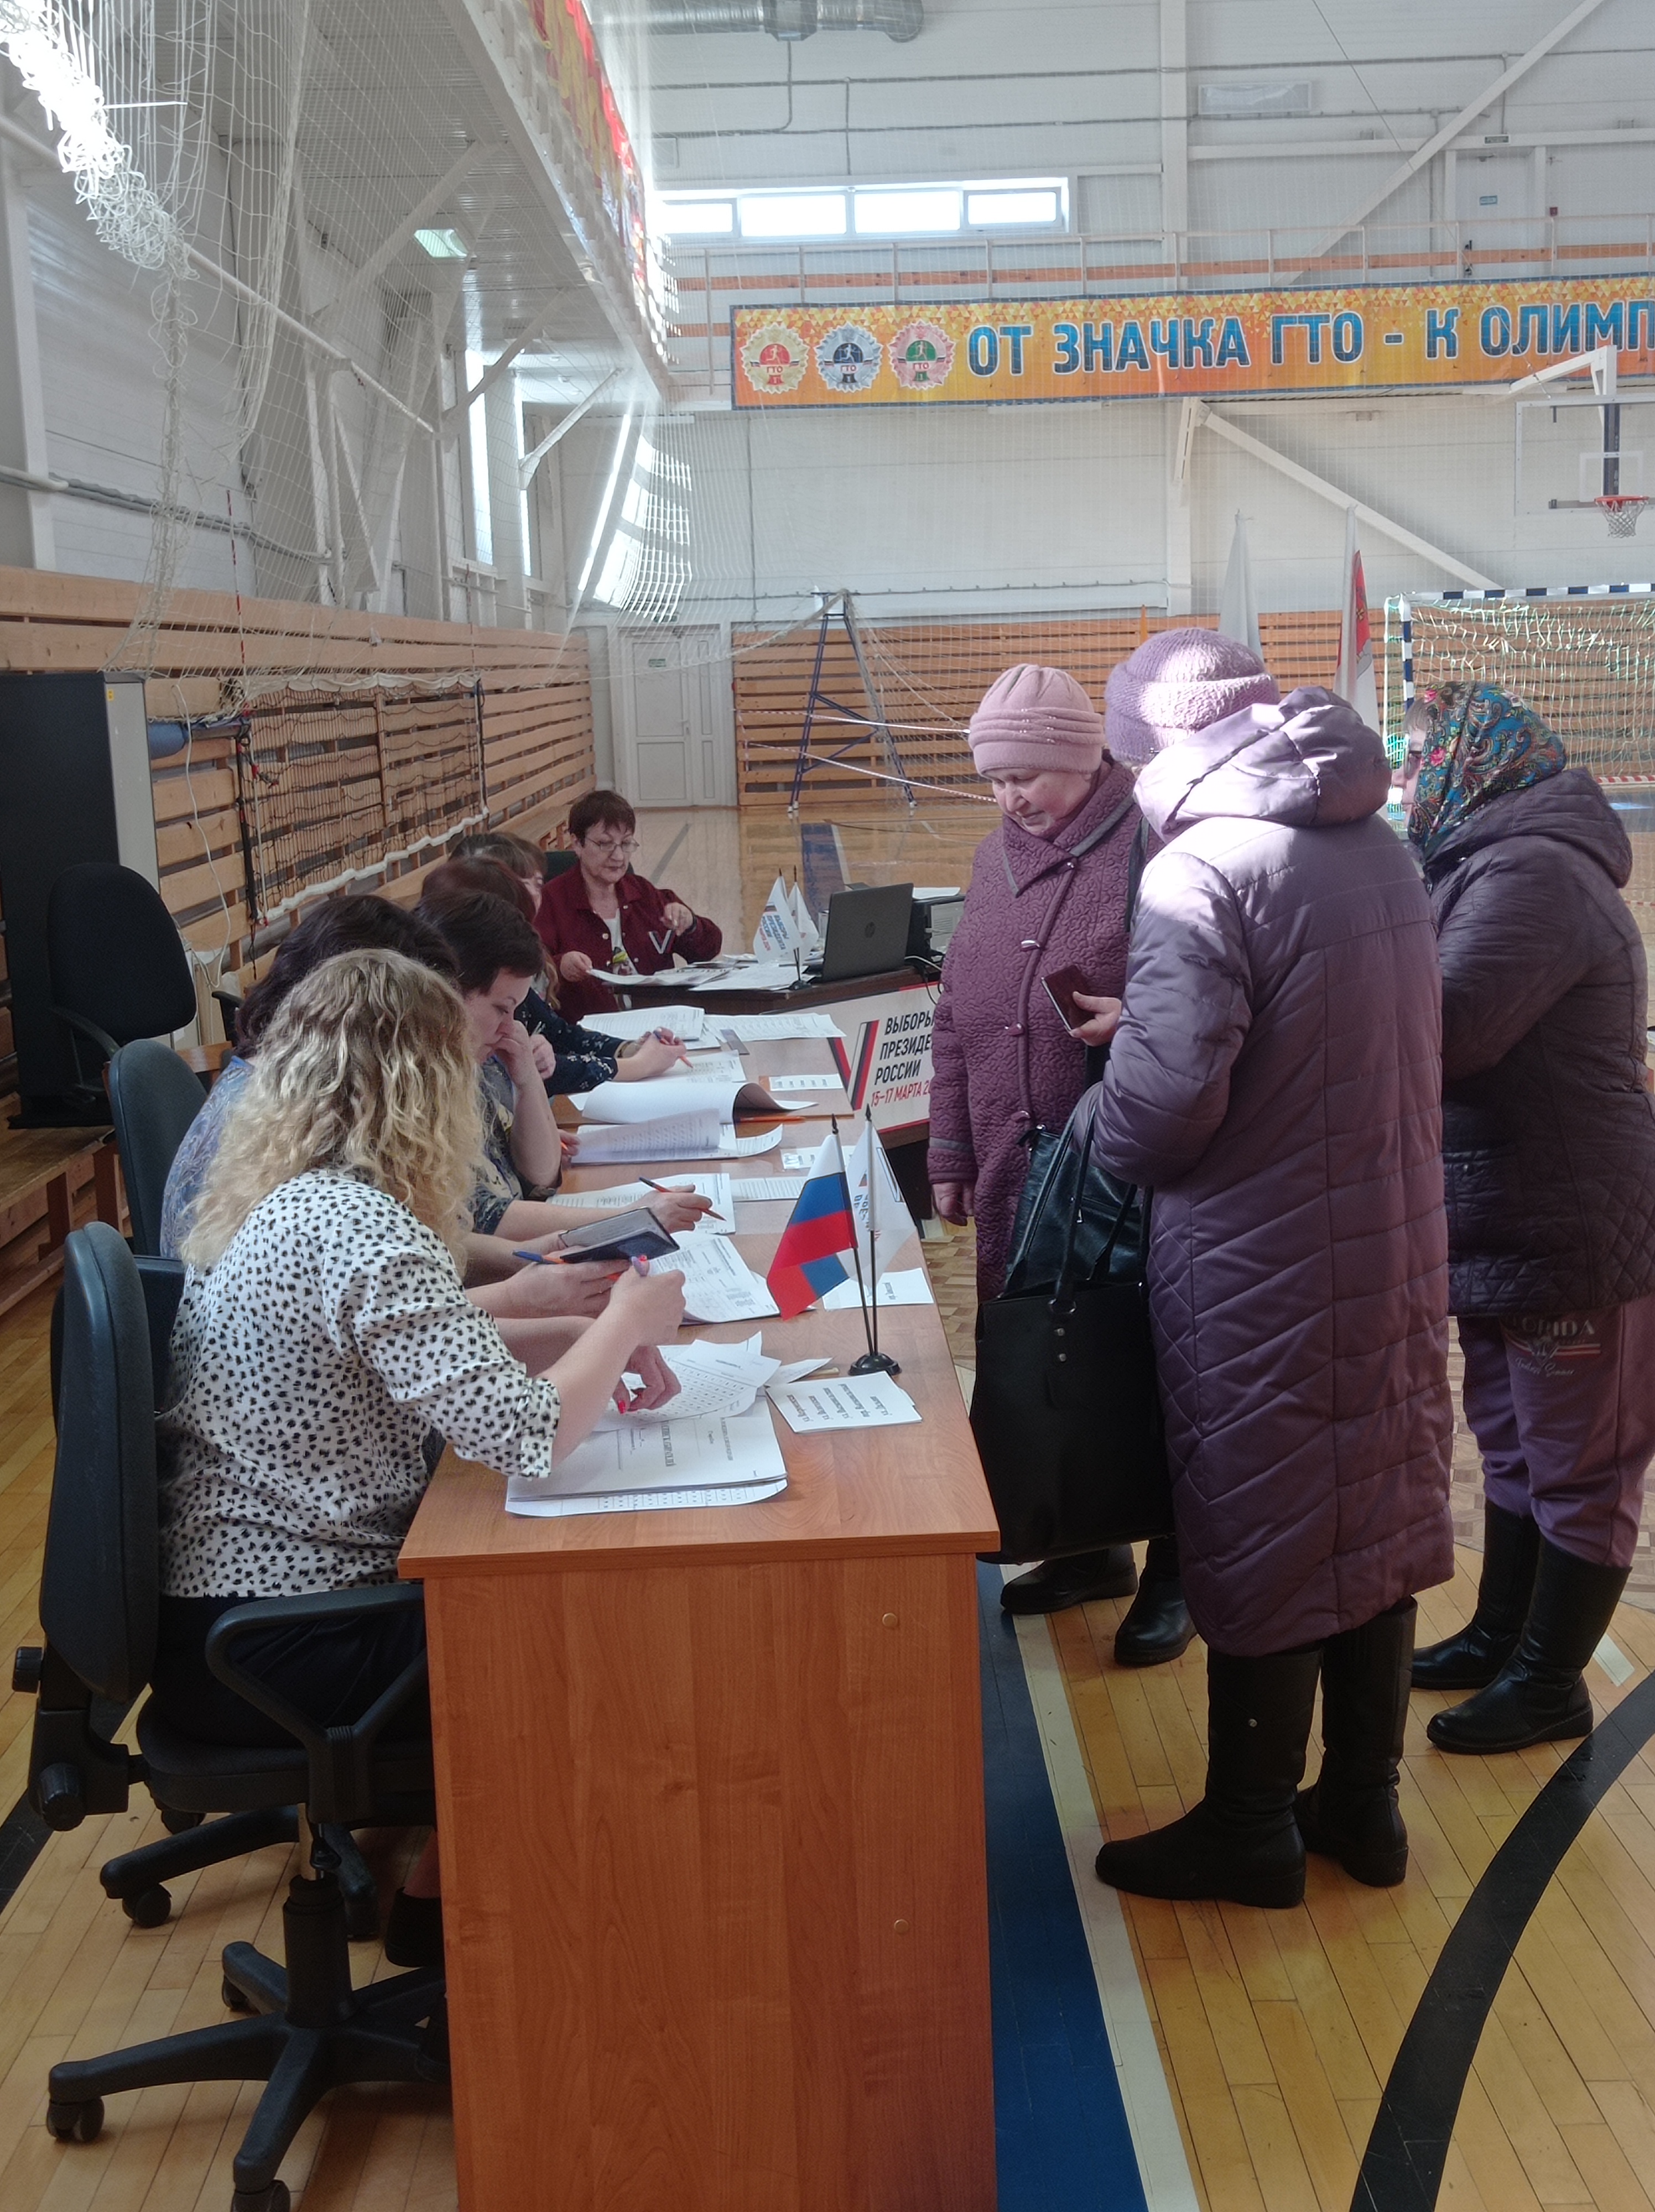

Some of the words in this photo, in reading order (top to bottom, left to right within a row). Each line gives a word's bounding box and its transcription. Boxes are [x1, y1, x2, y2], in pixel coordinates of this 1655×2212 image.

[967, 322, 1033, 377] ОТ
[1053, 316, 1252, 375] ЗНАЧКА
[1271, 310, 1364, 366] ГТО
[1425, 307, 1460, 359] К
[1479, 298, 1655, 357] ОЛИМП
[766, 365, 783, 373] ГТО
[913, 362, 929, 370] ГТО
[884, 1010, 934, 1036] ВЫБОРЫ
[879, 1033, 932, 1060] ПРЕЗИДЕ
[874, 1059, 922, 1086] РОССИИ
[894, 1081, 922, 1102] МАРТА
